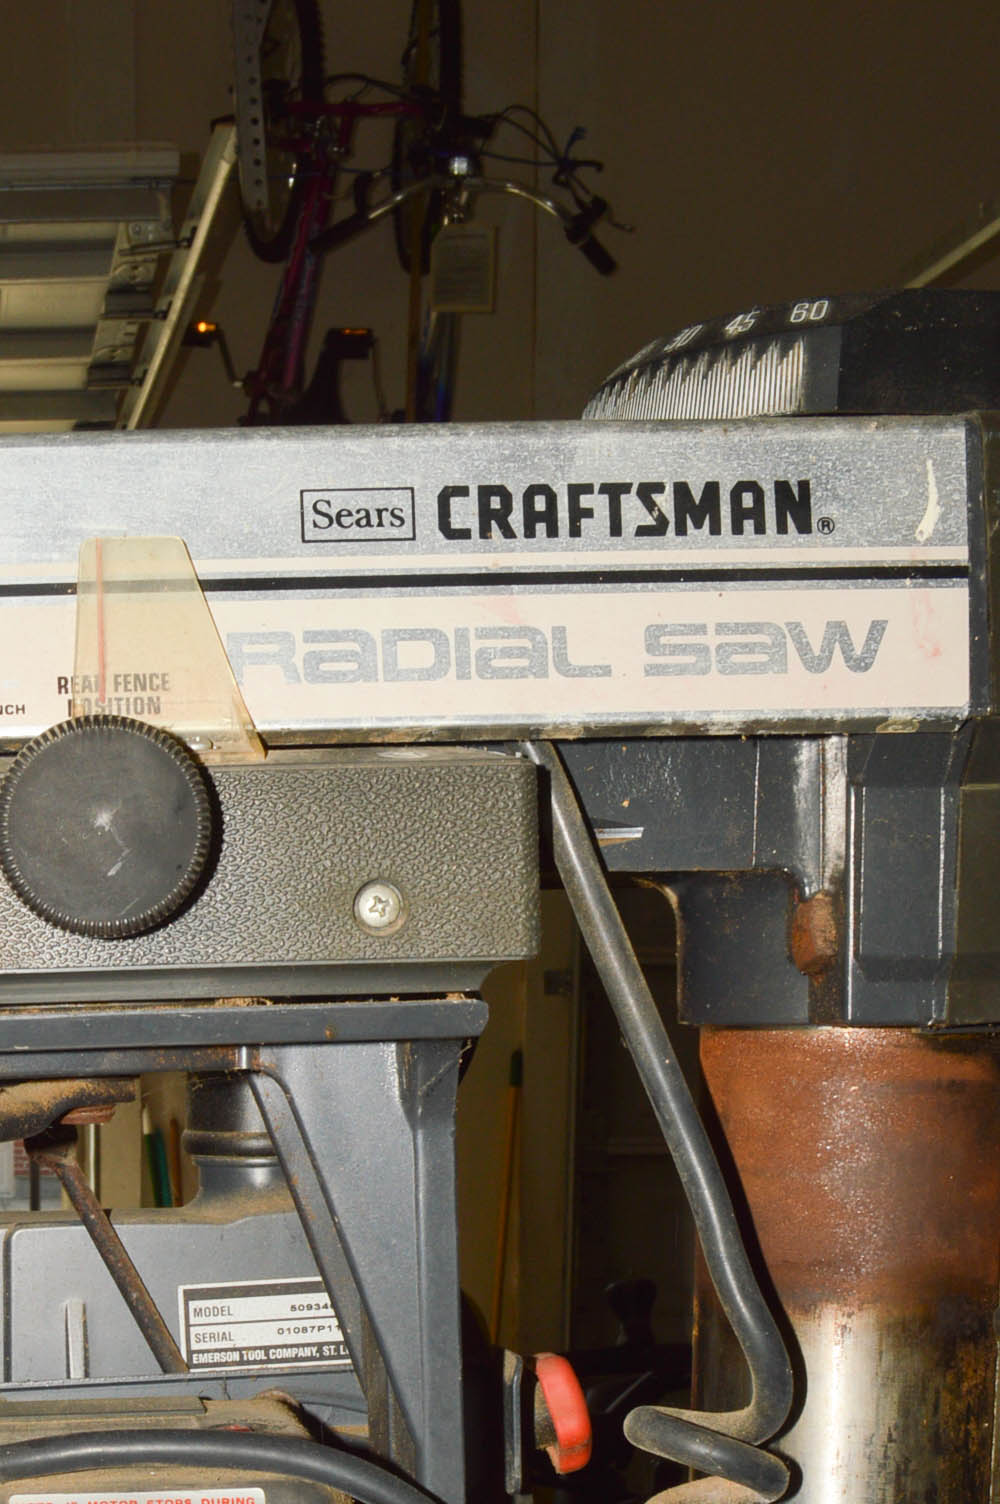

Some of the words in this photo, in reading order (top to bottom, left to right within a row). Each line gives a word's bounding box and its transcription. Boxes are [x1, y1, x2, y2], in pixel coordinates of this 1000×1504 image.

[725, 311, 760, 335] 45
[790, 299, 829, 323] 60
[310, 498, 406, 531] Sears
[113, 672, 171, 693] FENCE
[193, 1305, 233, 1318] MODEL
[194, 1331, 235, 1344] SERIAL
[192, 1352, 240, 1365] EMERSON
[241, 1350, 267, 1361] TOOL
[269, 1346, 320, 1360] COMPANY,
[322, 1346, 338, 1357] ST.
